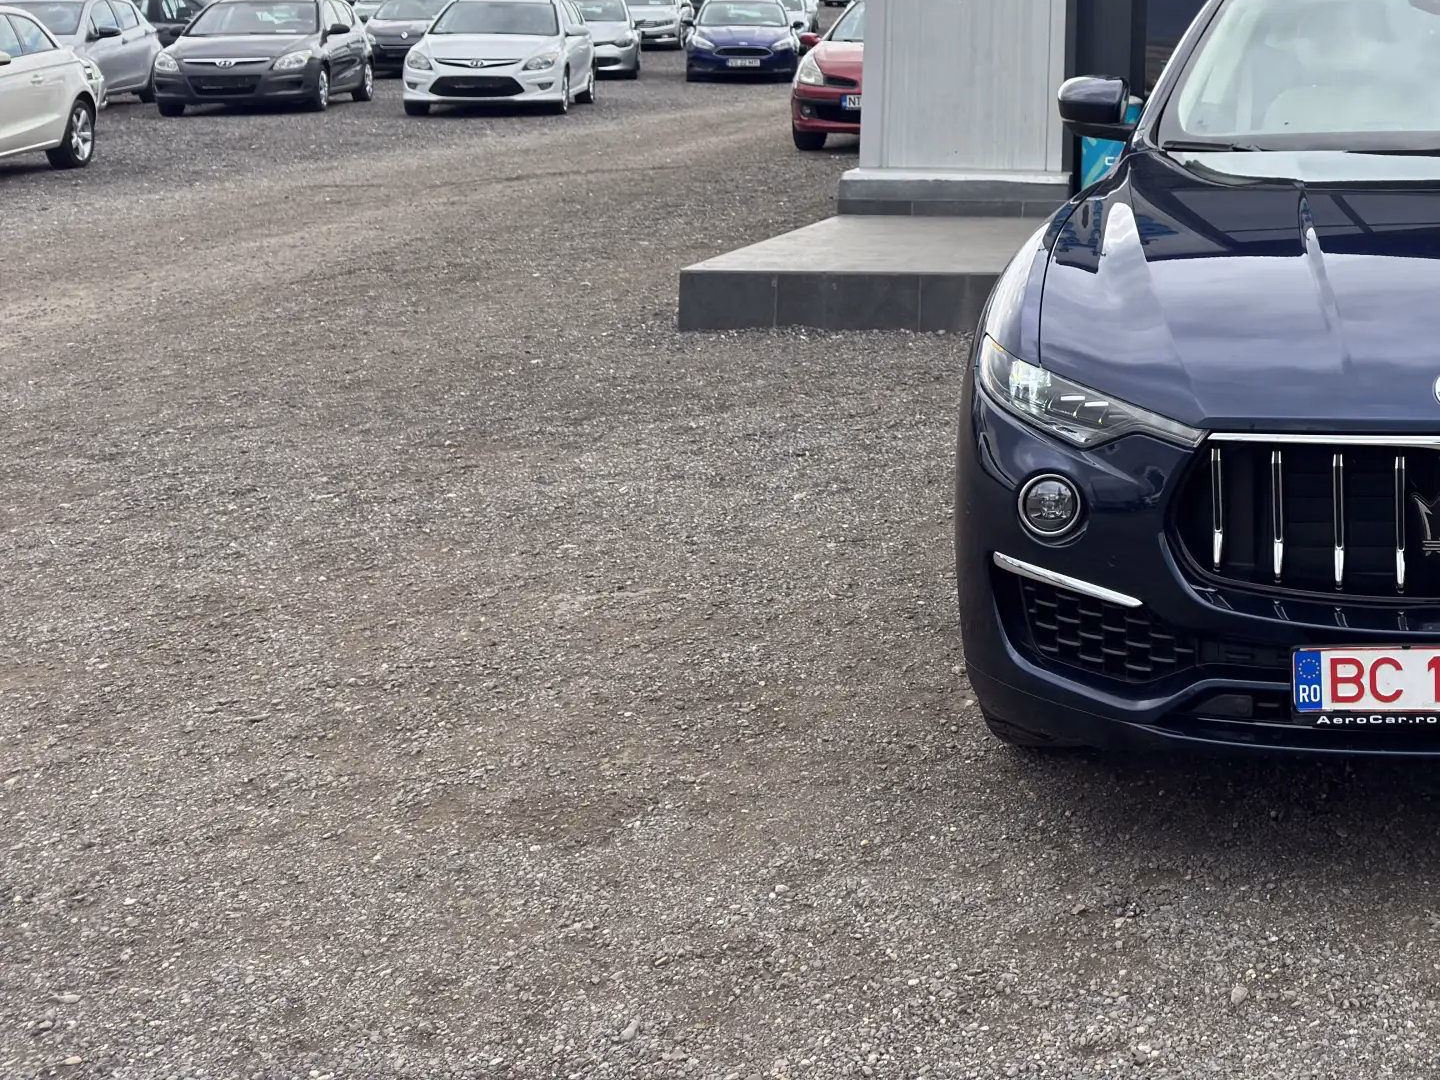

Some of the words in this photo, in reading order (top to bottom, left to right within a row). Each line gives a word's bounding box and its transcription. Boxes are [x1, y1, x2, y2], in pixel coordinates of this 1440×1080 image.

[1299, 684, 1321, 703] RO
[1330, 657, 1403, 703] BC
[1317, 715, 1438, 724] AeroCar.ro
